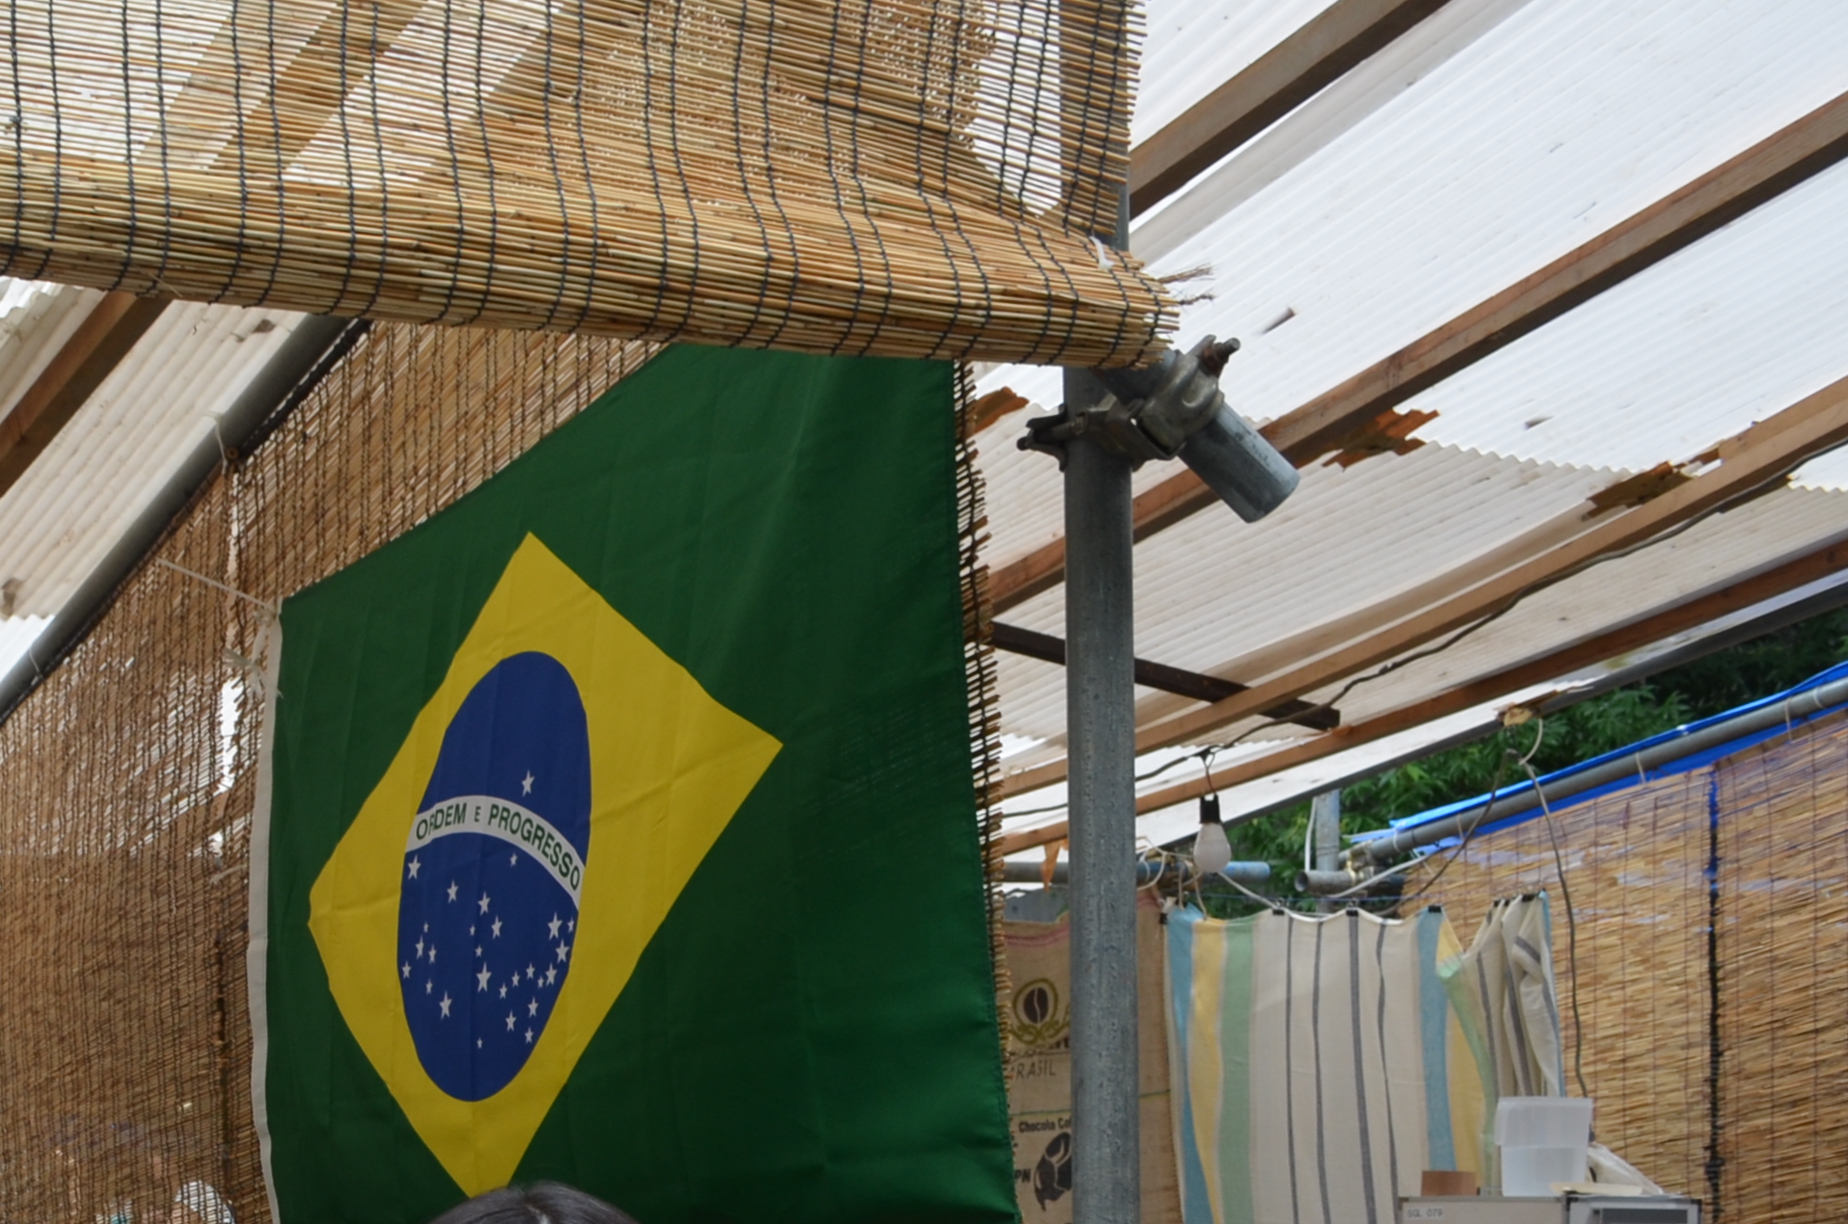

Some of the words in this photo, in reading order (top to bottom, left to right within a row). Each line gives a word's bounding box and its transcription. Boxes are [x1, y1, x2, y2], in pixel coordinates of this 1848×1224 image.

[474, 806, 481, 822] E
[487, 803, 580, 891] PROGRESSO
[1011, 1058, 1056, 1080] RASIL
